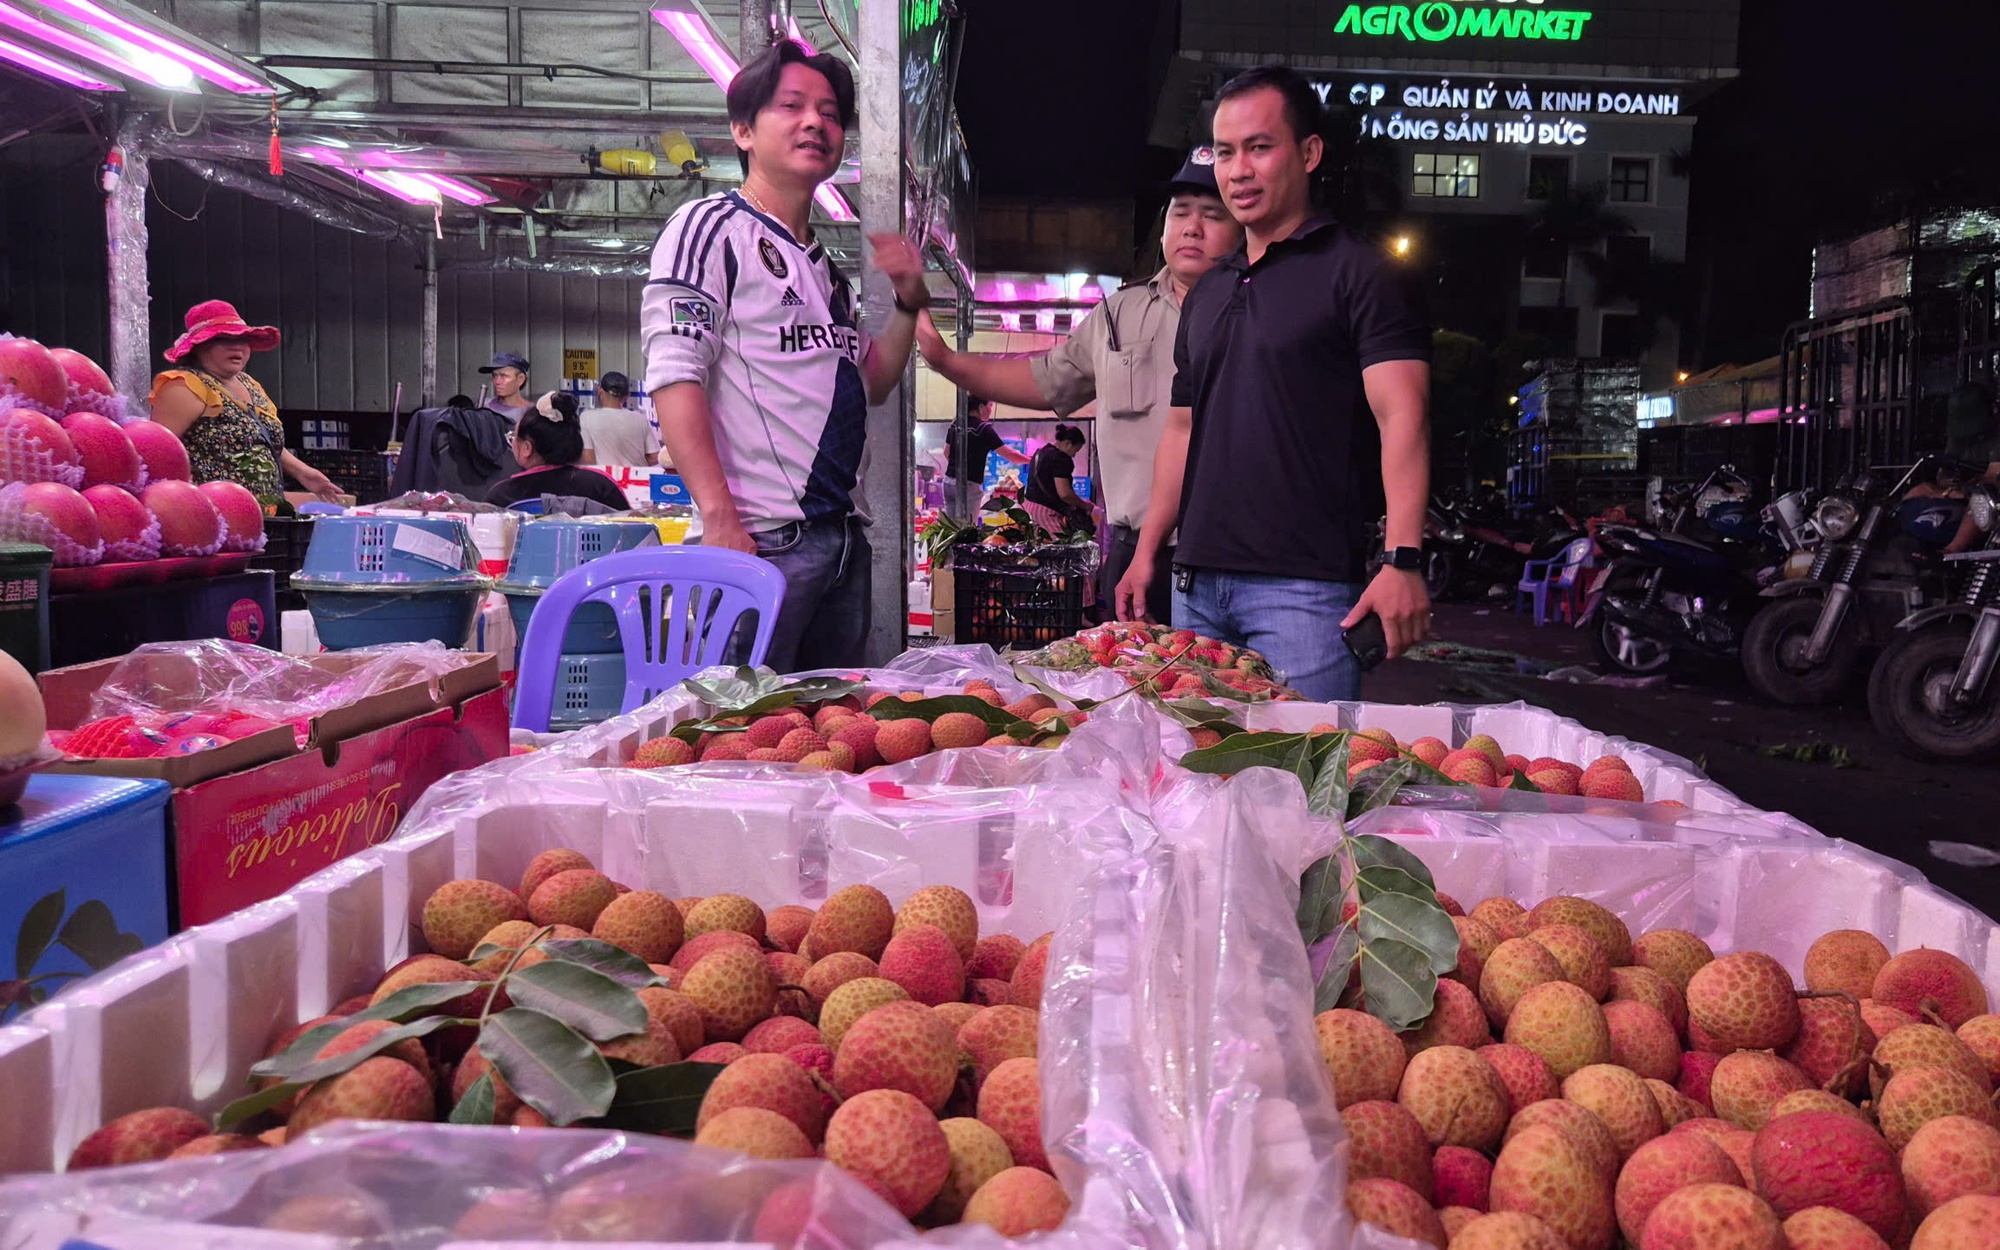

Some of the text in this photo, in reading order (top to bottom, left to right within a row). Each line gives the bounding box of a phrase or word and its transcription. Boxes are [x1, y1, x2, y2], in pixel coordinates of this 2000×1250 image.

[1334, 2, 1592, 41] AGROMARKET
[1403, 79, 1469, 108] QUẢN
[1475, 82, 1498, 109] LÝ
[1505, 83, 1532, 111] VÀ
[1541, 91, 1591, 112] KINH
[1597, 92, 1679, 115] DOANH
[1443, 113, 1488, 142] SẢN
[1494, 114, 1534, 144] THỦ
[1538, 117, 1587, 145] ĐỨC
[564, 350, 596, 360] CAUTION
[226, 782, 401, 879] Delicious
